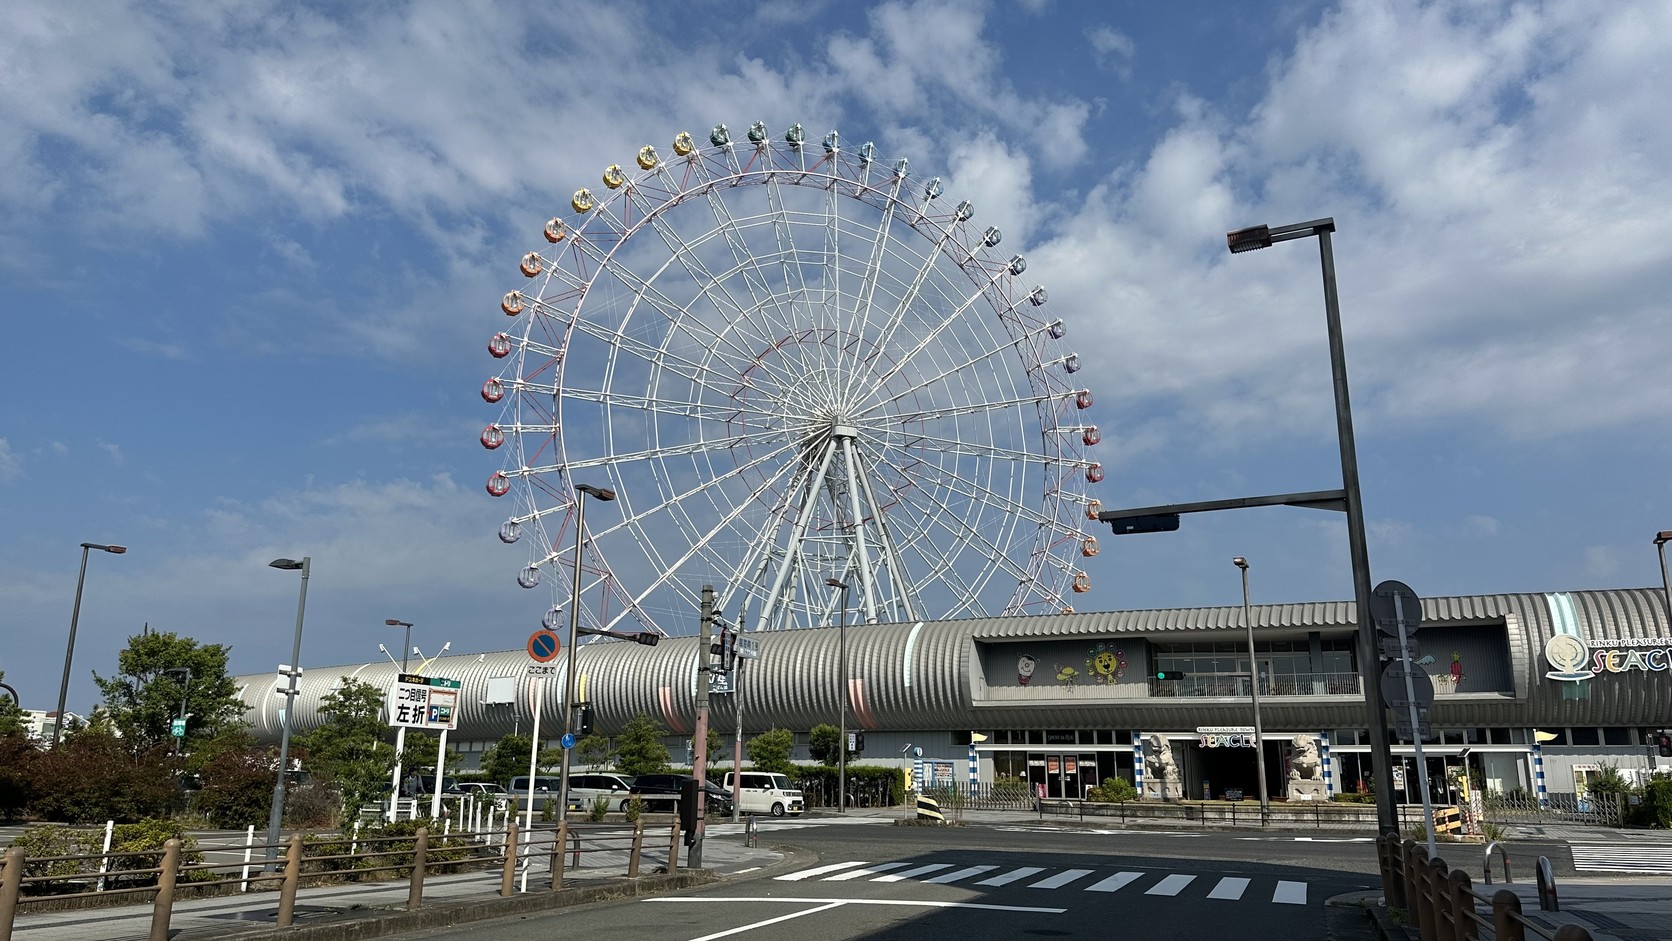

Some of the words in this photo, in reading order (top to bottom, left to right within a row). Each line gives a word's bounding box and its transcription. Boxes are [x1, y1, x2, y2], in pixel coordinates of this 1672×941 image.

[1590, 640, 1619, 648] RINKU
[1621, 638, 1665, 647] PLEASURE
[528, 666, 556, 674] ここまで
[396, 704, 425, 724] 左折
[432, 708, 438, 719] P
